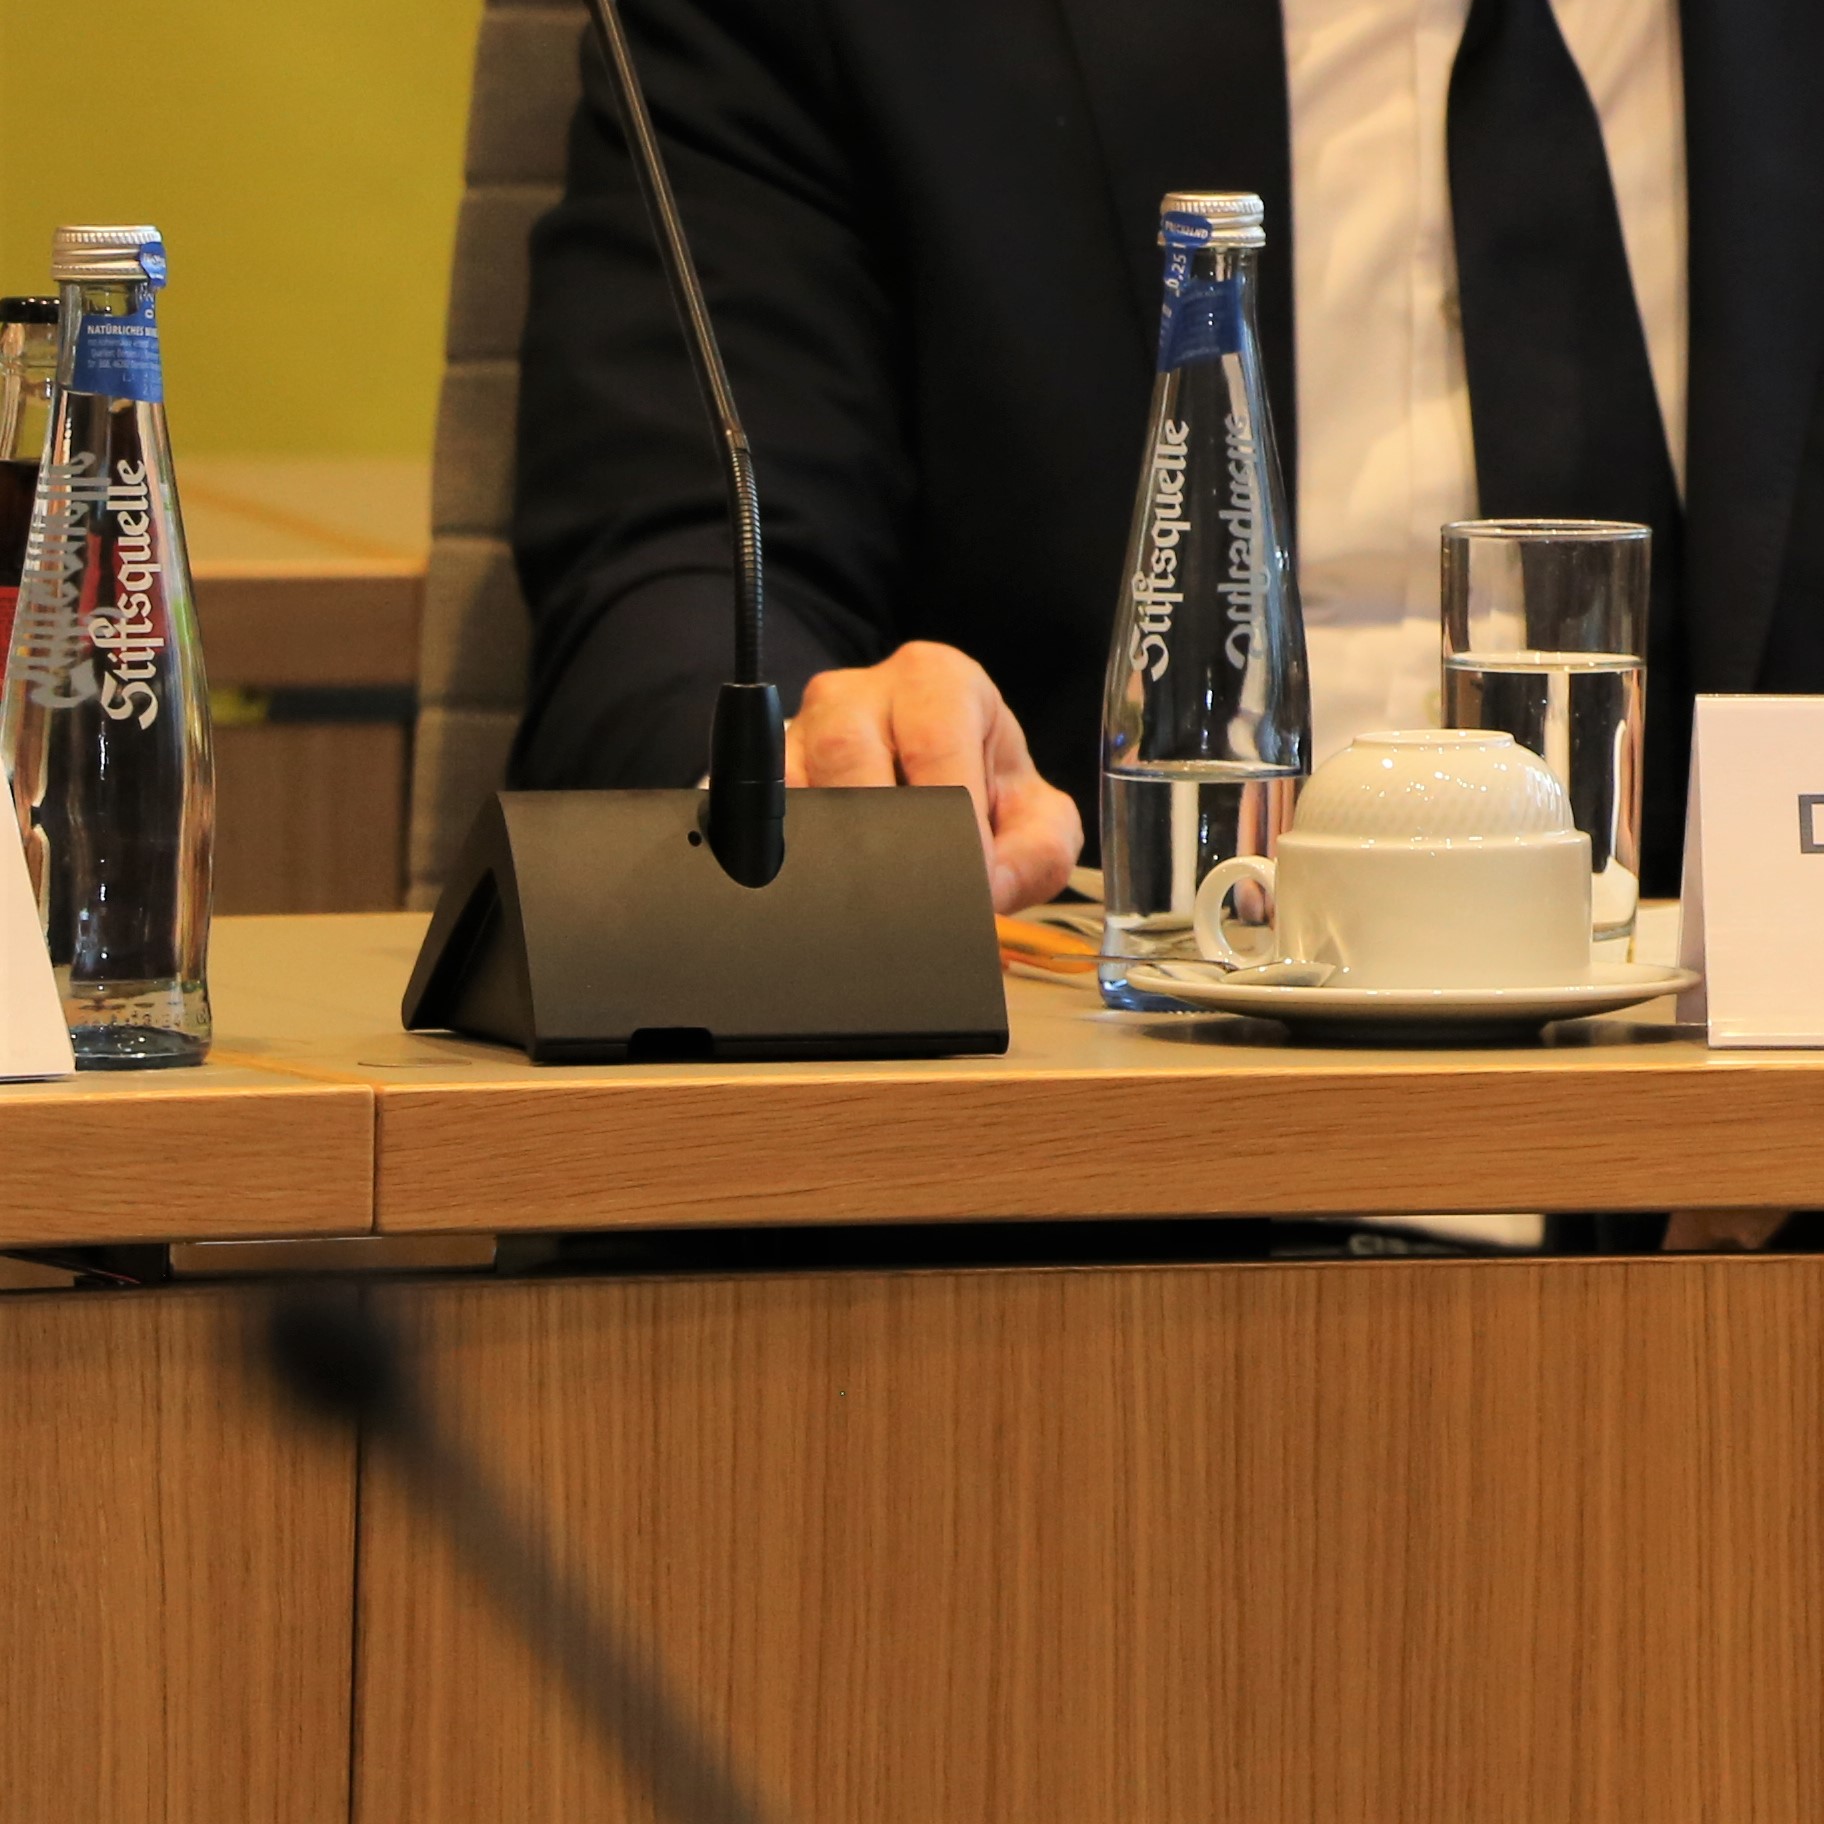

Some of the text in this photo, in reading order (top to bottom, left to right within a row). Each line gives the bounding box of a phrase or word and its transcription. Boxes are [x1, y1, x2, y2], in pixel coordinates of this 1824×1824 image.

[87, 323, 144, 337] NATÜRLICHES
[88, 458, 165, 730] Stiftsquelle
[1129, 418, 1192, 682] Stiftsquelle
